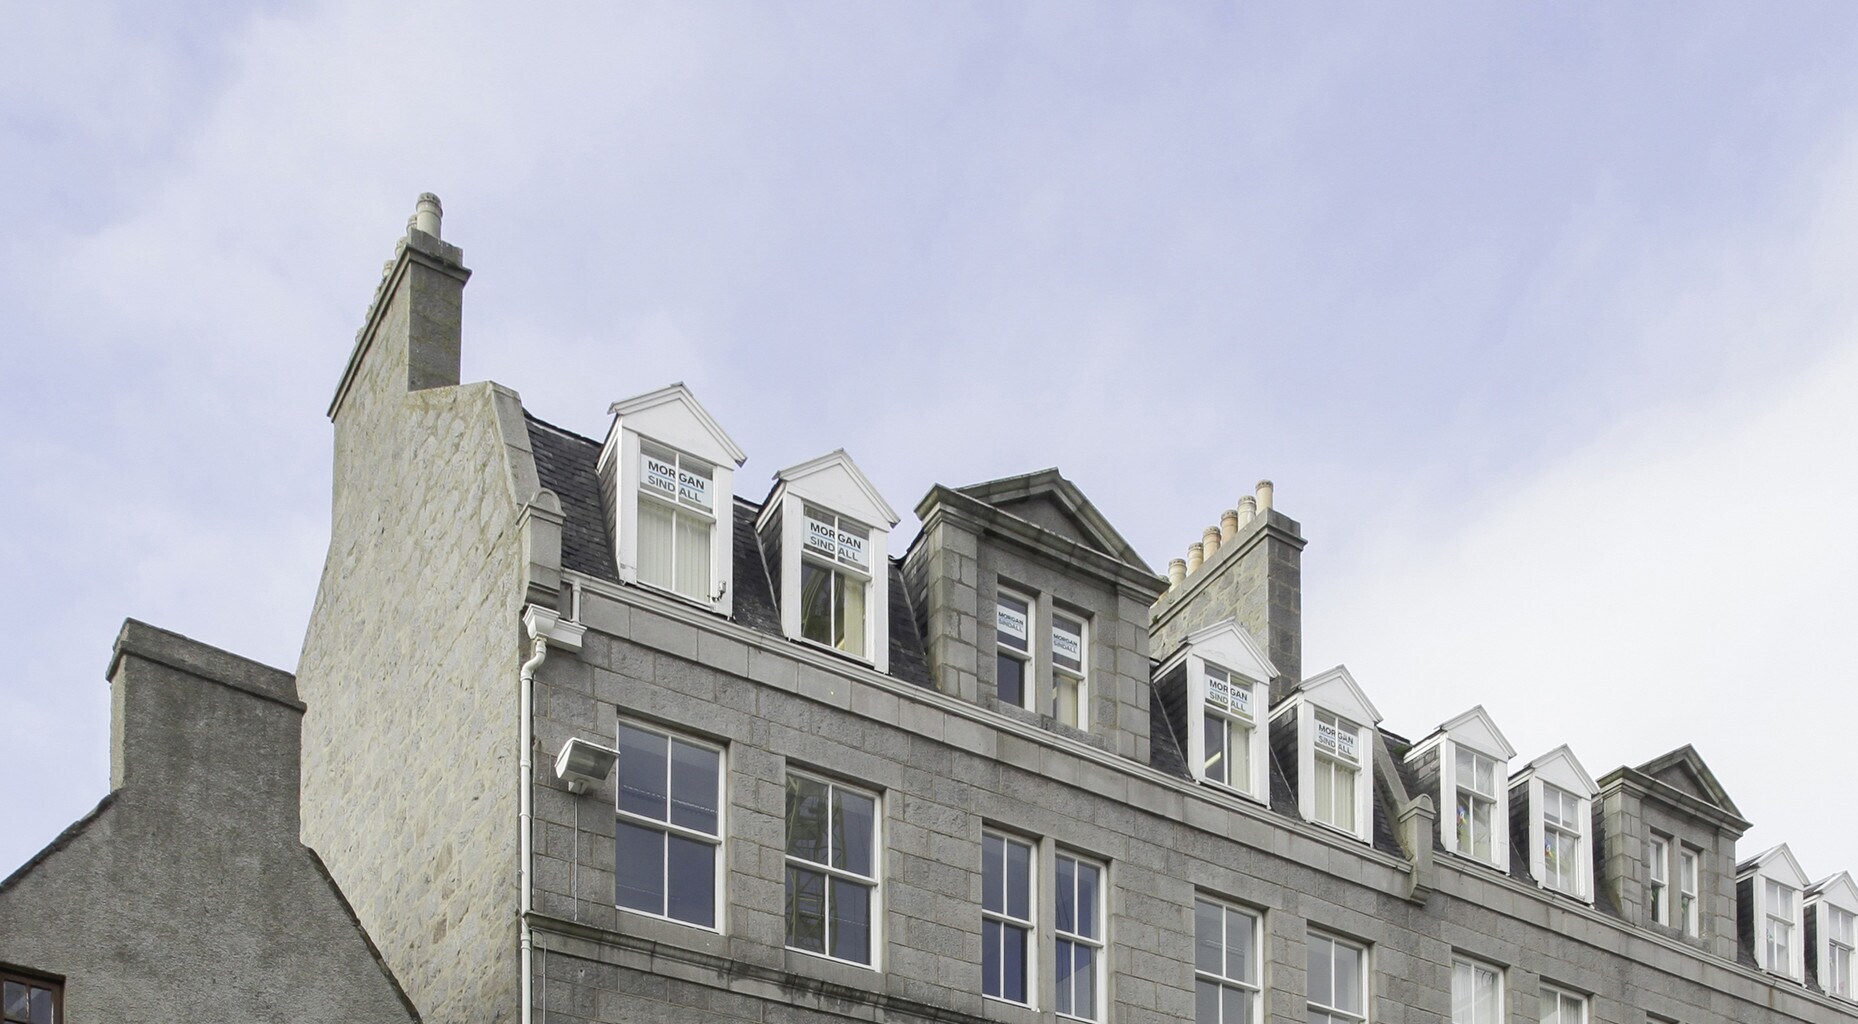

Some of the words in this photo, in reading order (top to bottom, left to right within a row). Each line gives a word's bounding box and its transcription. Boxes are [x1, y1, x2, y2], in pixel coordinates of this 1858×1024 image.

[648, 460, 704, 490] MORGAN
[810, 522, 861, 549] MORGAN
[998, 611, 1024, 626] MORGAN
[998, 618, 1024, 633] SINDALL
[1053, 633, 1078, 647] MORGAN
[1053, 641, 1077, 654] SINDALL
[1209, 679, 1247, 701] MORGAN
[1318, 723, 1354, 744] MORGAN
